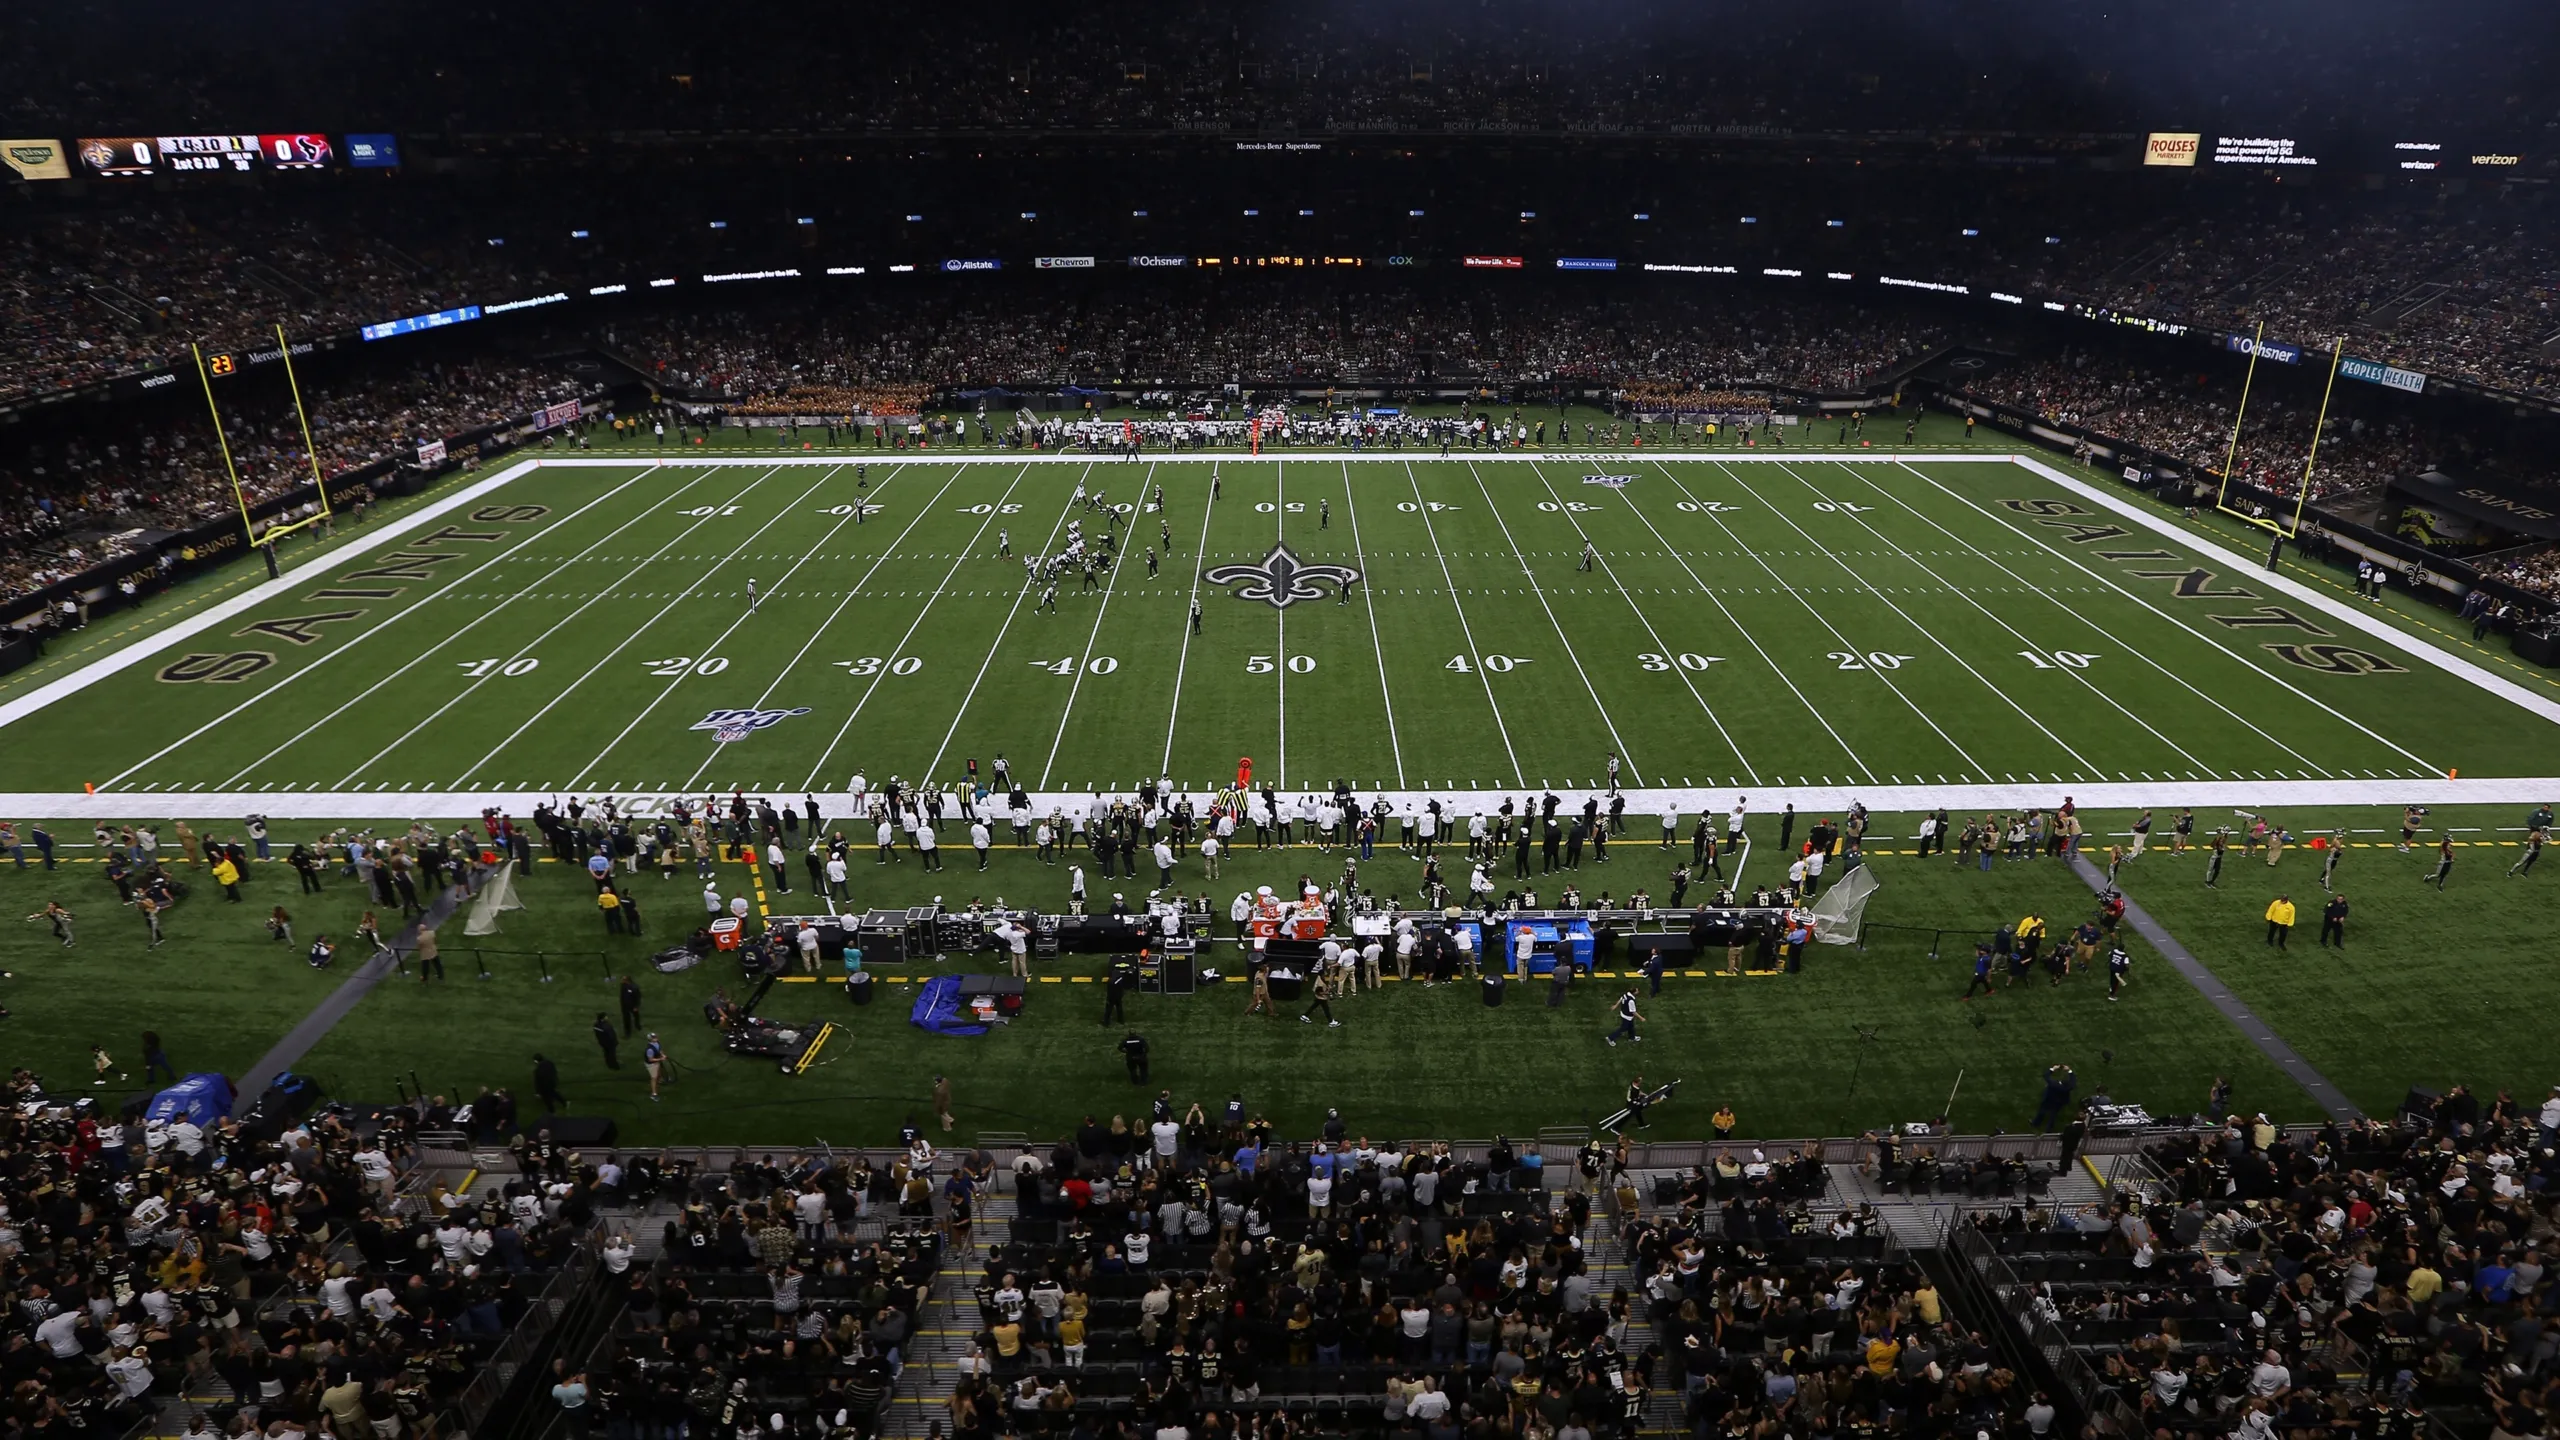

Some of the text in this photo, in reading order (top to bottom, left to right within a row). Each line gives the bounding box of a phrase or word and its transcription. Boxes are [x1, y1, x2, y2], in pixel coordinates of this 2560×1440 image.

[1194, 122, 1231, 130] BENSON
[1325, 122, 1398, 130] ARCHIE MANNING
[1444, 122, 1520, 131] RICKEY JACKSON
[1671, 125, 1768, 134] MORTEN ANDERSEN
[1286, 143, 1321, 151] Superdome
[2151, 140, 2195, 152] ROUSES
[2218, 137, 2294, 148] We're building the
[132, 142, 152, 164] 0
[275, 140, 292, 160] 0
[2216, 147, 2293, 156] most powerful 5G
[172, 158, 194, 170] 1st
[203, 157, 219, 169] 10
[2214, 155, 2317, 165] experience for America.
[2401, 161, 2435, 170] verizon
[2472, 154, 2517, 165] verizon
[962, 260, 993, 269] Allstate
[1054, 257, 1089, 266] Chevron
[1140, 256, 1183, 266] Ochsner
[1389, 256, 1413, 265] COX
[211, 355, 231, 374] 23
[2341, 360, 2382, 381] PEOPLES
[140, 373, 176, 389] verizon
[2384, 369, 2424, 390] HEALTH
[1997, 413, 2023, 430] SAINTS
[449, 444, 479, 462] SAINTS
[2456, 488, 2555, 519] SAINTS
[197, 532, 238, 559] SAINTS
[155, 505, 552, 684] SAINTS
[1995, 499, 2411, 677] SAINTS
[650, 657, 729, 676] 20
[847, 657, 922, 676] 30
[1046, 656, 1119, 675] 40
[1246, 655, 1317, 674] 50
[1445, 655, 1514, 673] 40
[1637, 652, 1710, 672] 30
[1826, 652, 1901, 671] 20
[2017, 650, 2090, 669] 10
[462, 658, 539, 676] 10
[719, 730, 743, 740] NFL
[1200, 903, 1206, 913] 9
[1260, 924, 1275, 936] G
[541, 1147, 551, 1158] 9
[1587, 1156, 1599, 1168] 71
[519, 1207, 531, 1216] 99
[691, 1233, 706, 1247] 13
[1307, 1261, 1320, 1276] 41
[1201, 1367, 1219, 1379] 80
[1624, 1403, 1639, 1418] 11
